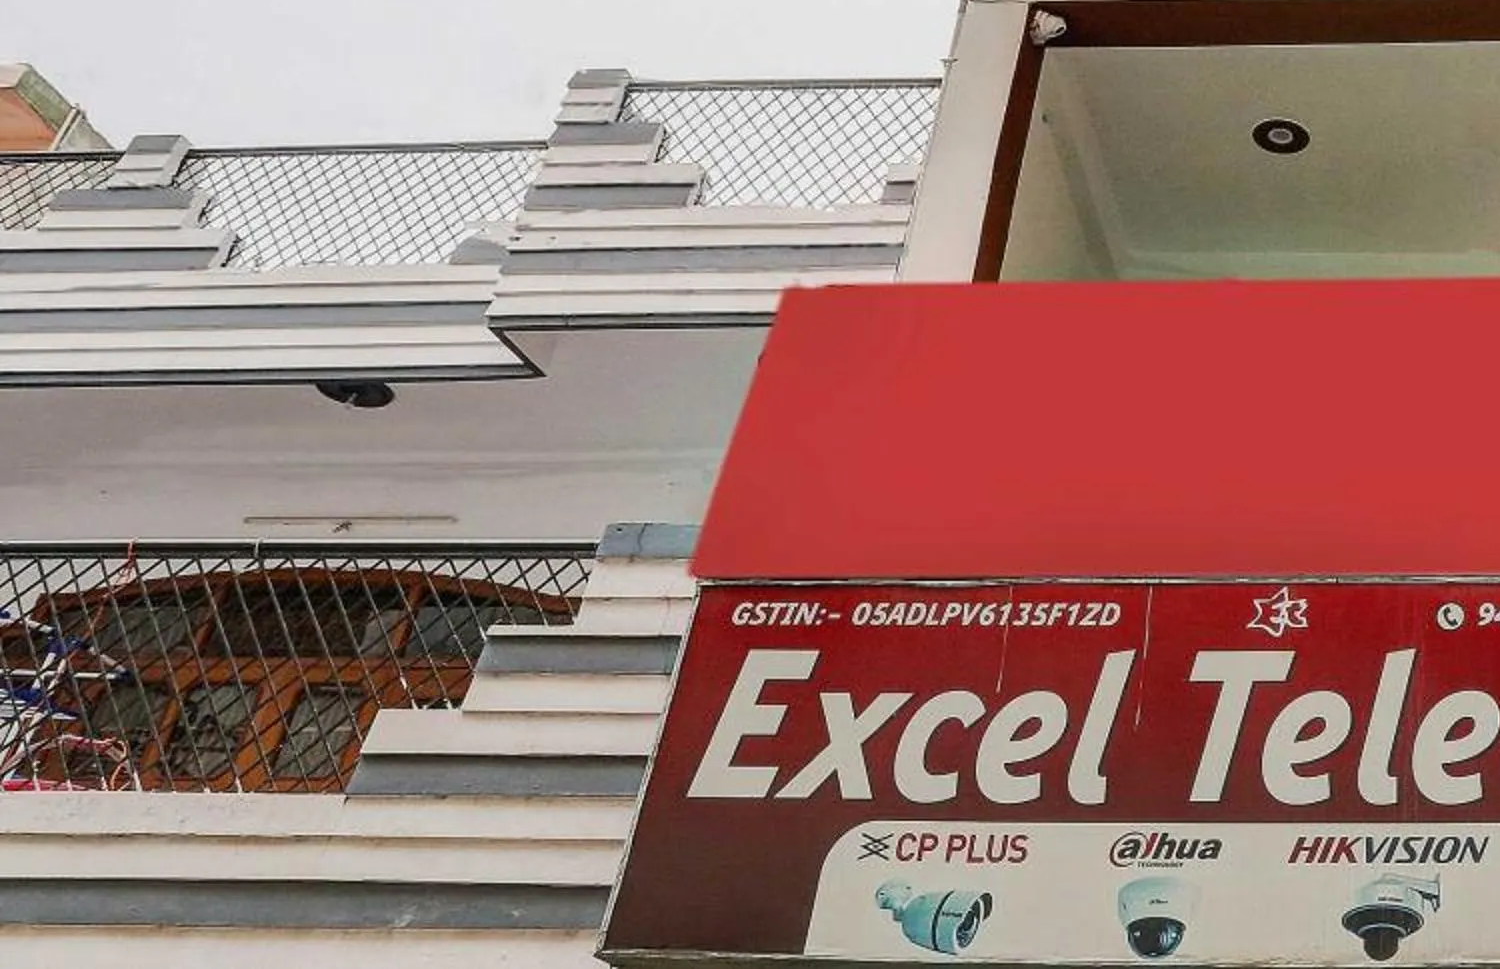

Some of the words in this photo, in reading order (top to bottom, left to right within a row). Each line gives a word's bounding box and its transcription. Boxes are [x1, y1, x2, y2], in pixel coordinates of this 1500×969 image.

[687, 648, 1136, 806] Excel
[895, 832, 939, 863] CP
[945, 832, 1030, 864] PLUS
[1287, 836, 1490, 864] HIKVISION
